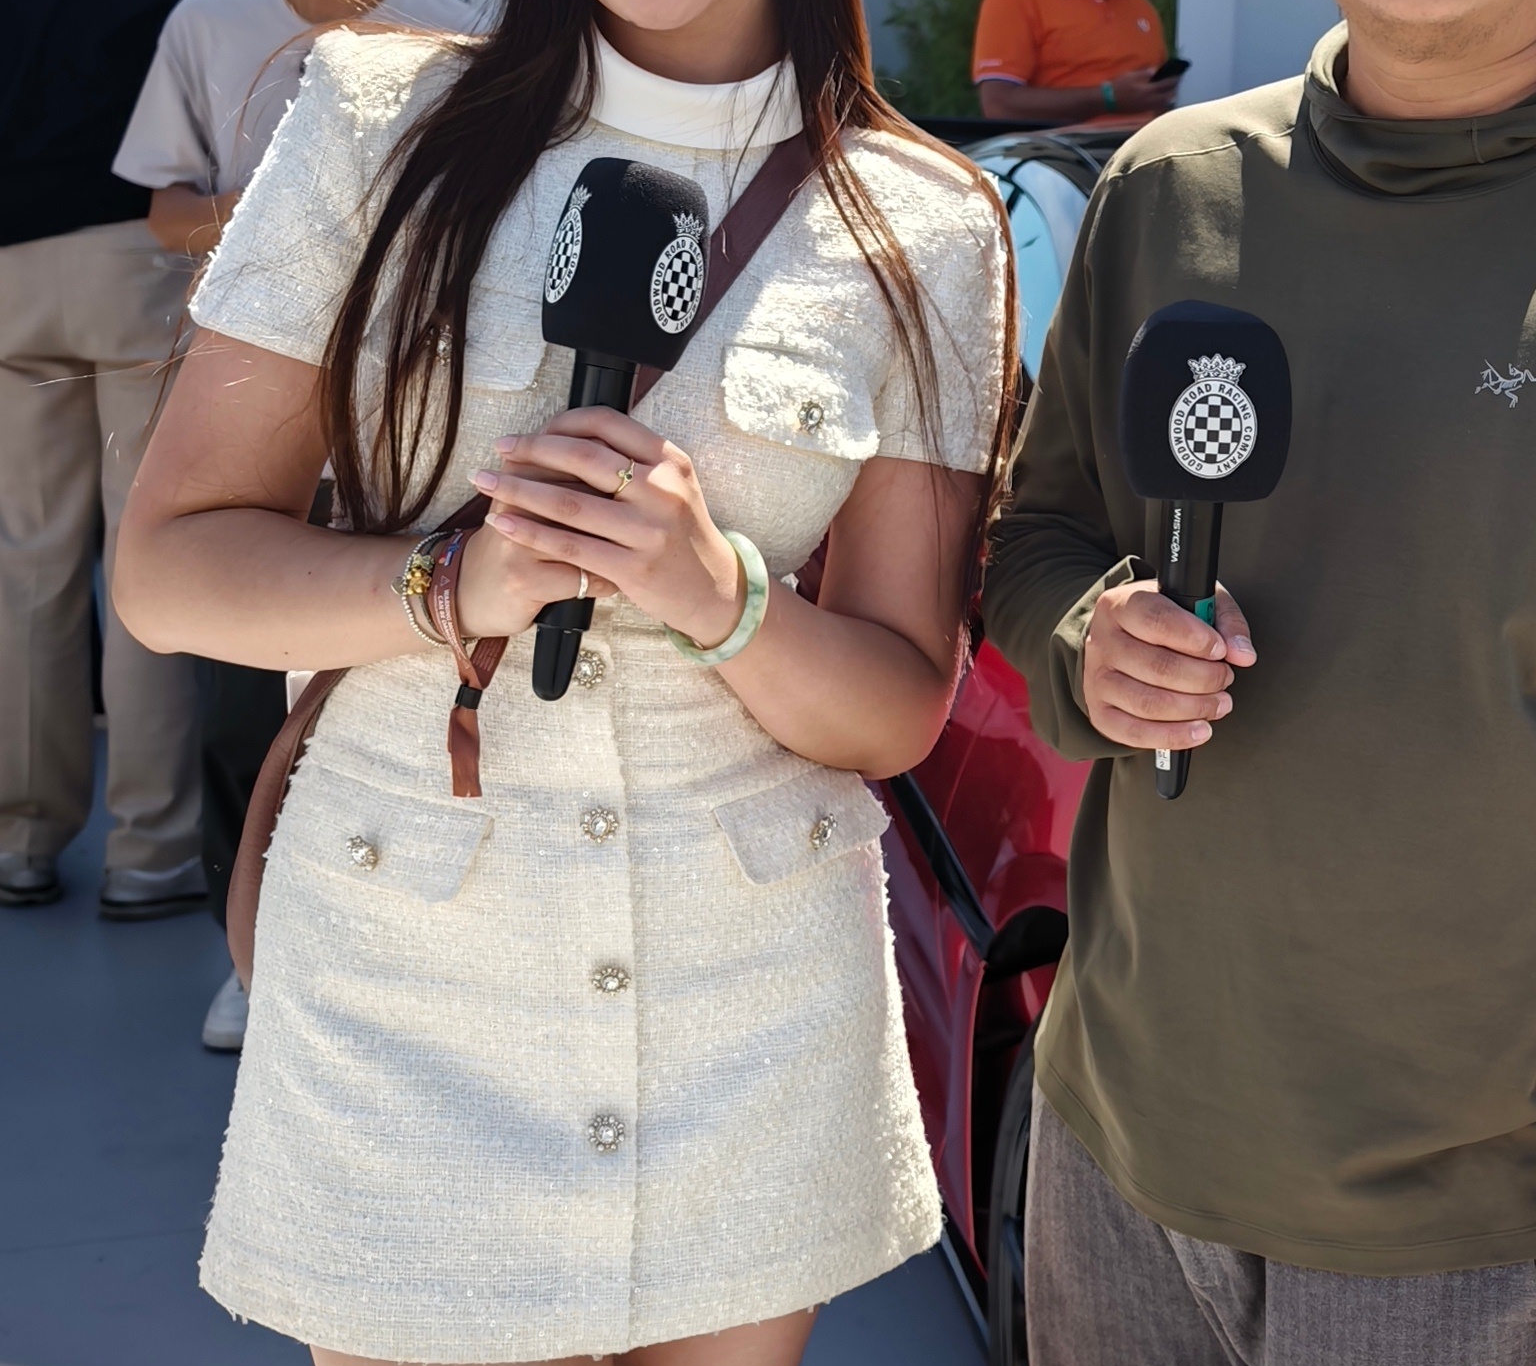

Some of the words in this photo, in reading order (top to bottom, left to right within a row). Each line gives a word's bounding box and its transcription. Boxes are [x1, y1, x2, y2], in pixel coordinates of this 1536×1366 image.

[653, 262, 669, 327] GOODWOOD
[665, 239, 686, 260] ROAD
[1182, 383, 1212, 407] ROAD
[1218, 383, 1252, 421] RACING
[1173, 409, 1204, 472] GOODWOOD
[1216, 425, 1253, 474] COMPANY
[1159, 760, 1165, 768] 2
